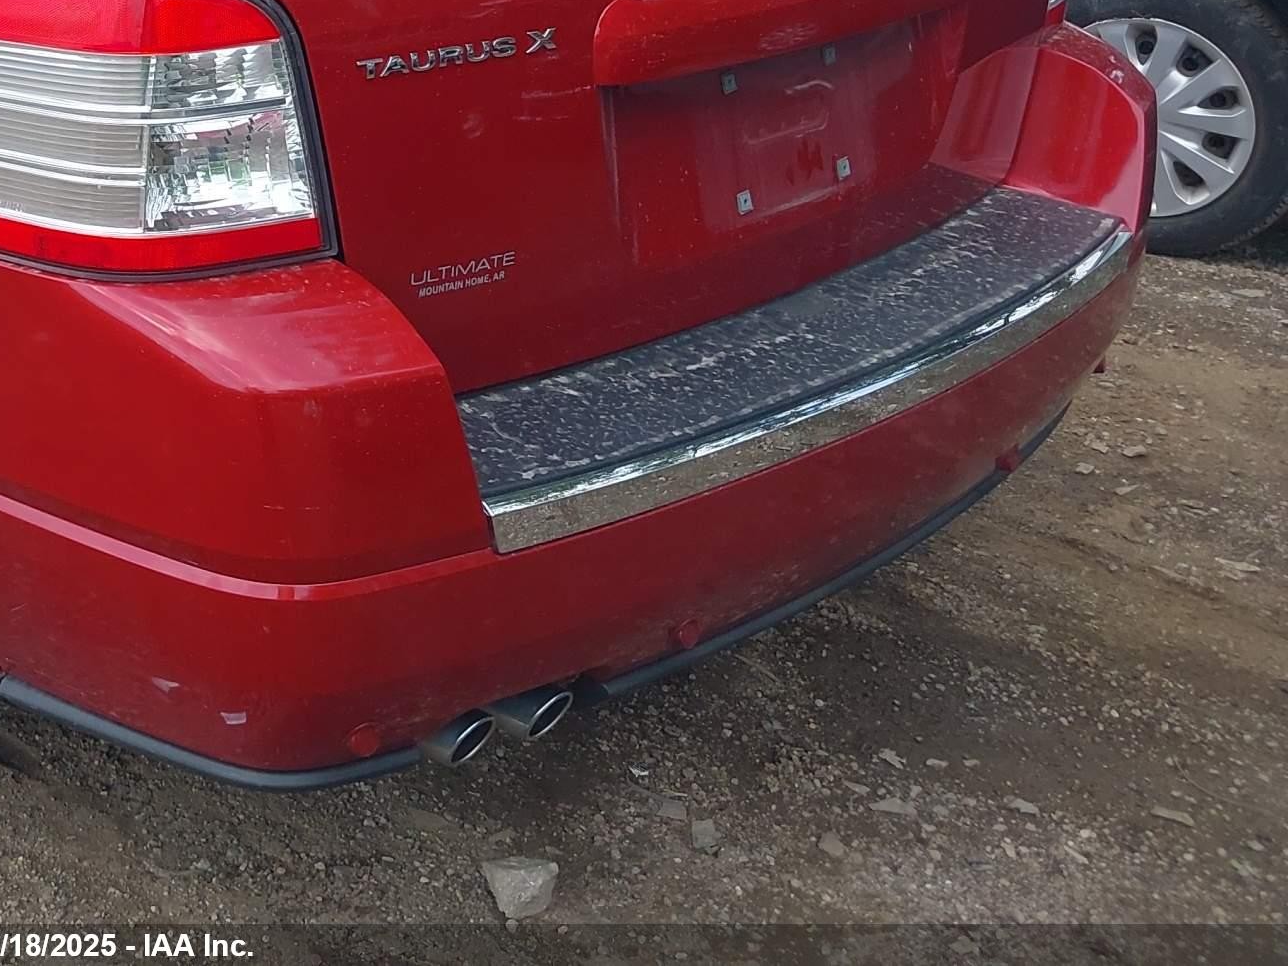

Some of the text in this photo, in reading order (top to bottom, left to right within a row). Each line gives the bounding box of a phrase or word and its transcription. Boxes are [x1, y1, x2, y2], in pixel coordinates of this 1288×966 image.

[356, 27, 558, 80] TAURUS X
[410, 251, 516, 286] ULTIMATE
[418, 280, 464, 299] MOUNTAIN
[493, 270, 505, 281] AR
